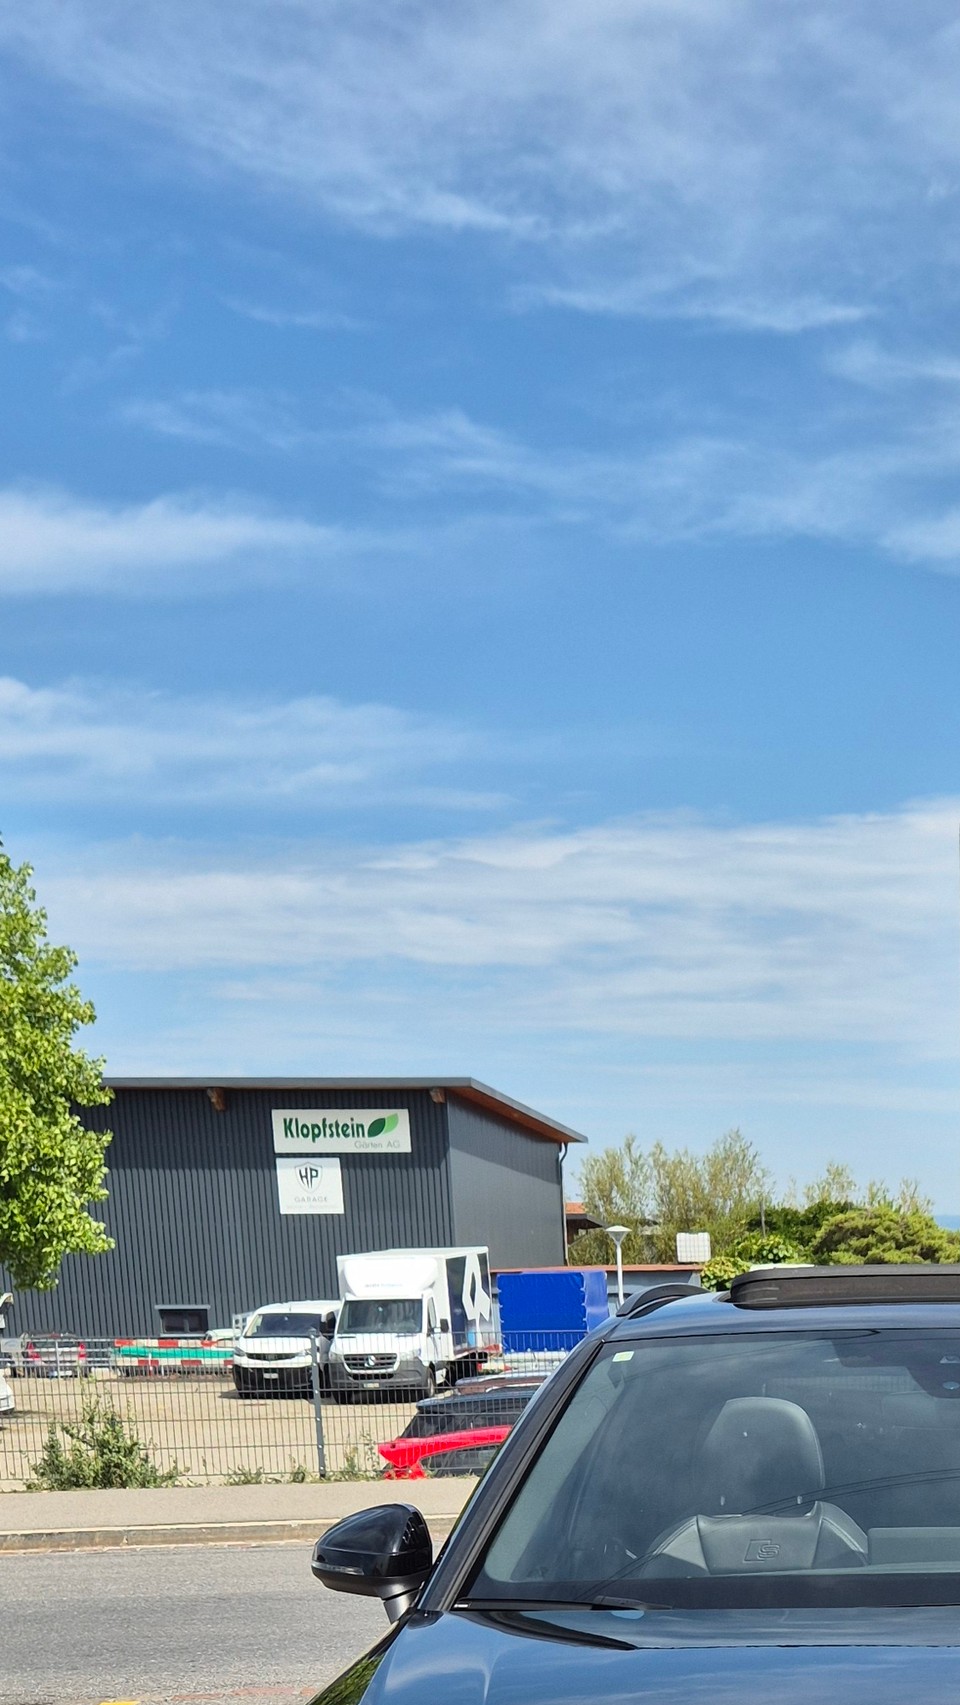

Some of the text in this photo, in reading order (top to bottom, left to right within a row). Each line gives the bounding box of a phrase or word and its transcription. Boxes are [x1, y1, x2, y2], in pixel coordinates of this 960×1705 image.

[283, 1117, 366, 1143] Klopfstein
[386, 1140, 401, 1149] AG
[299, 1167, 319, 1189] HP
